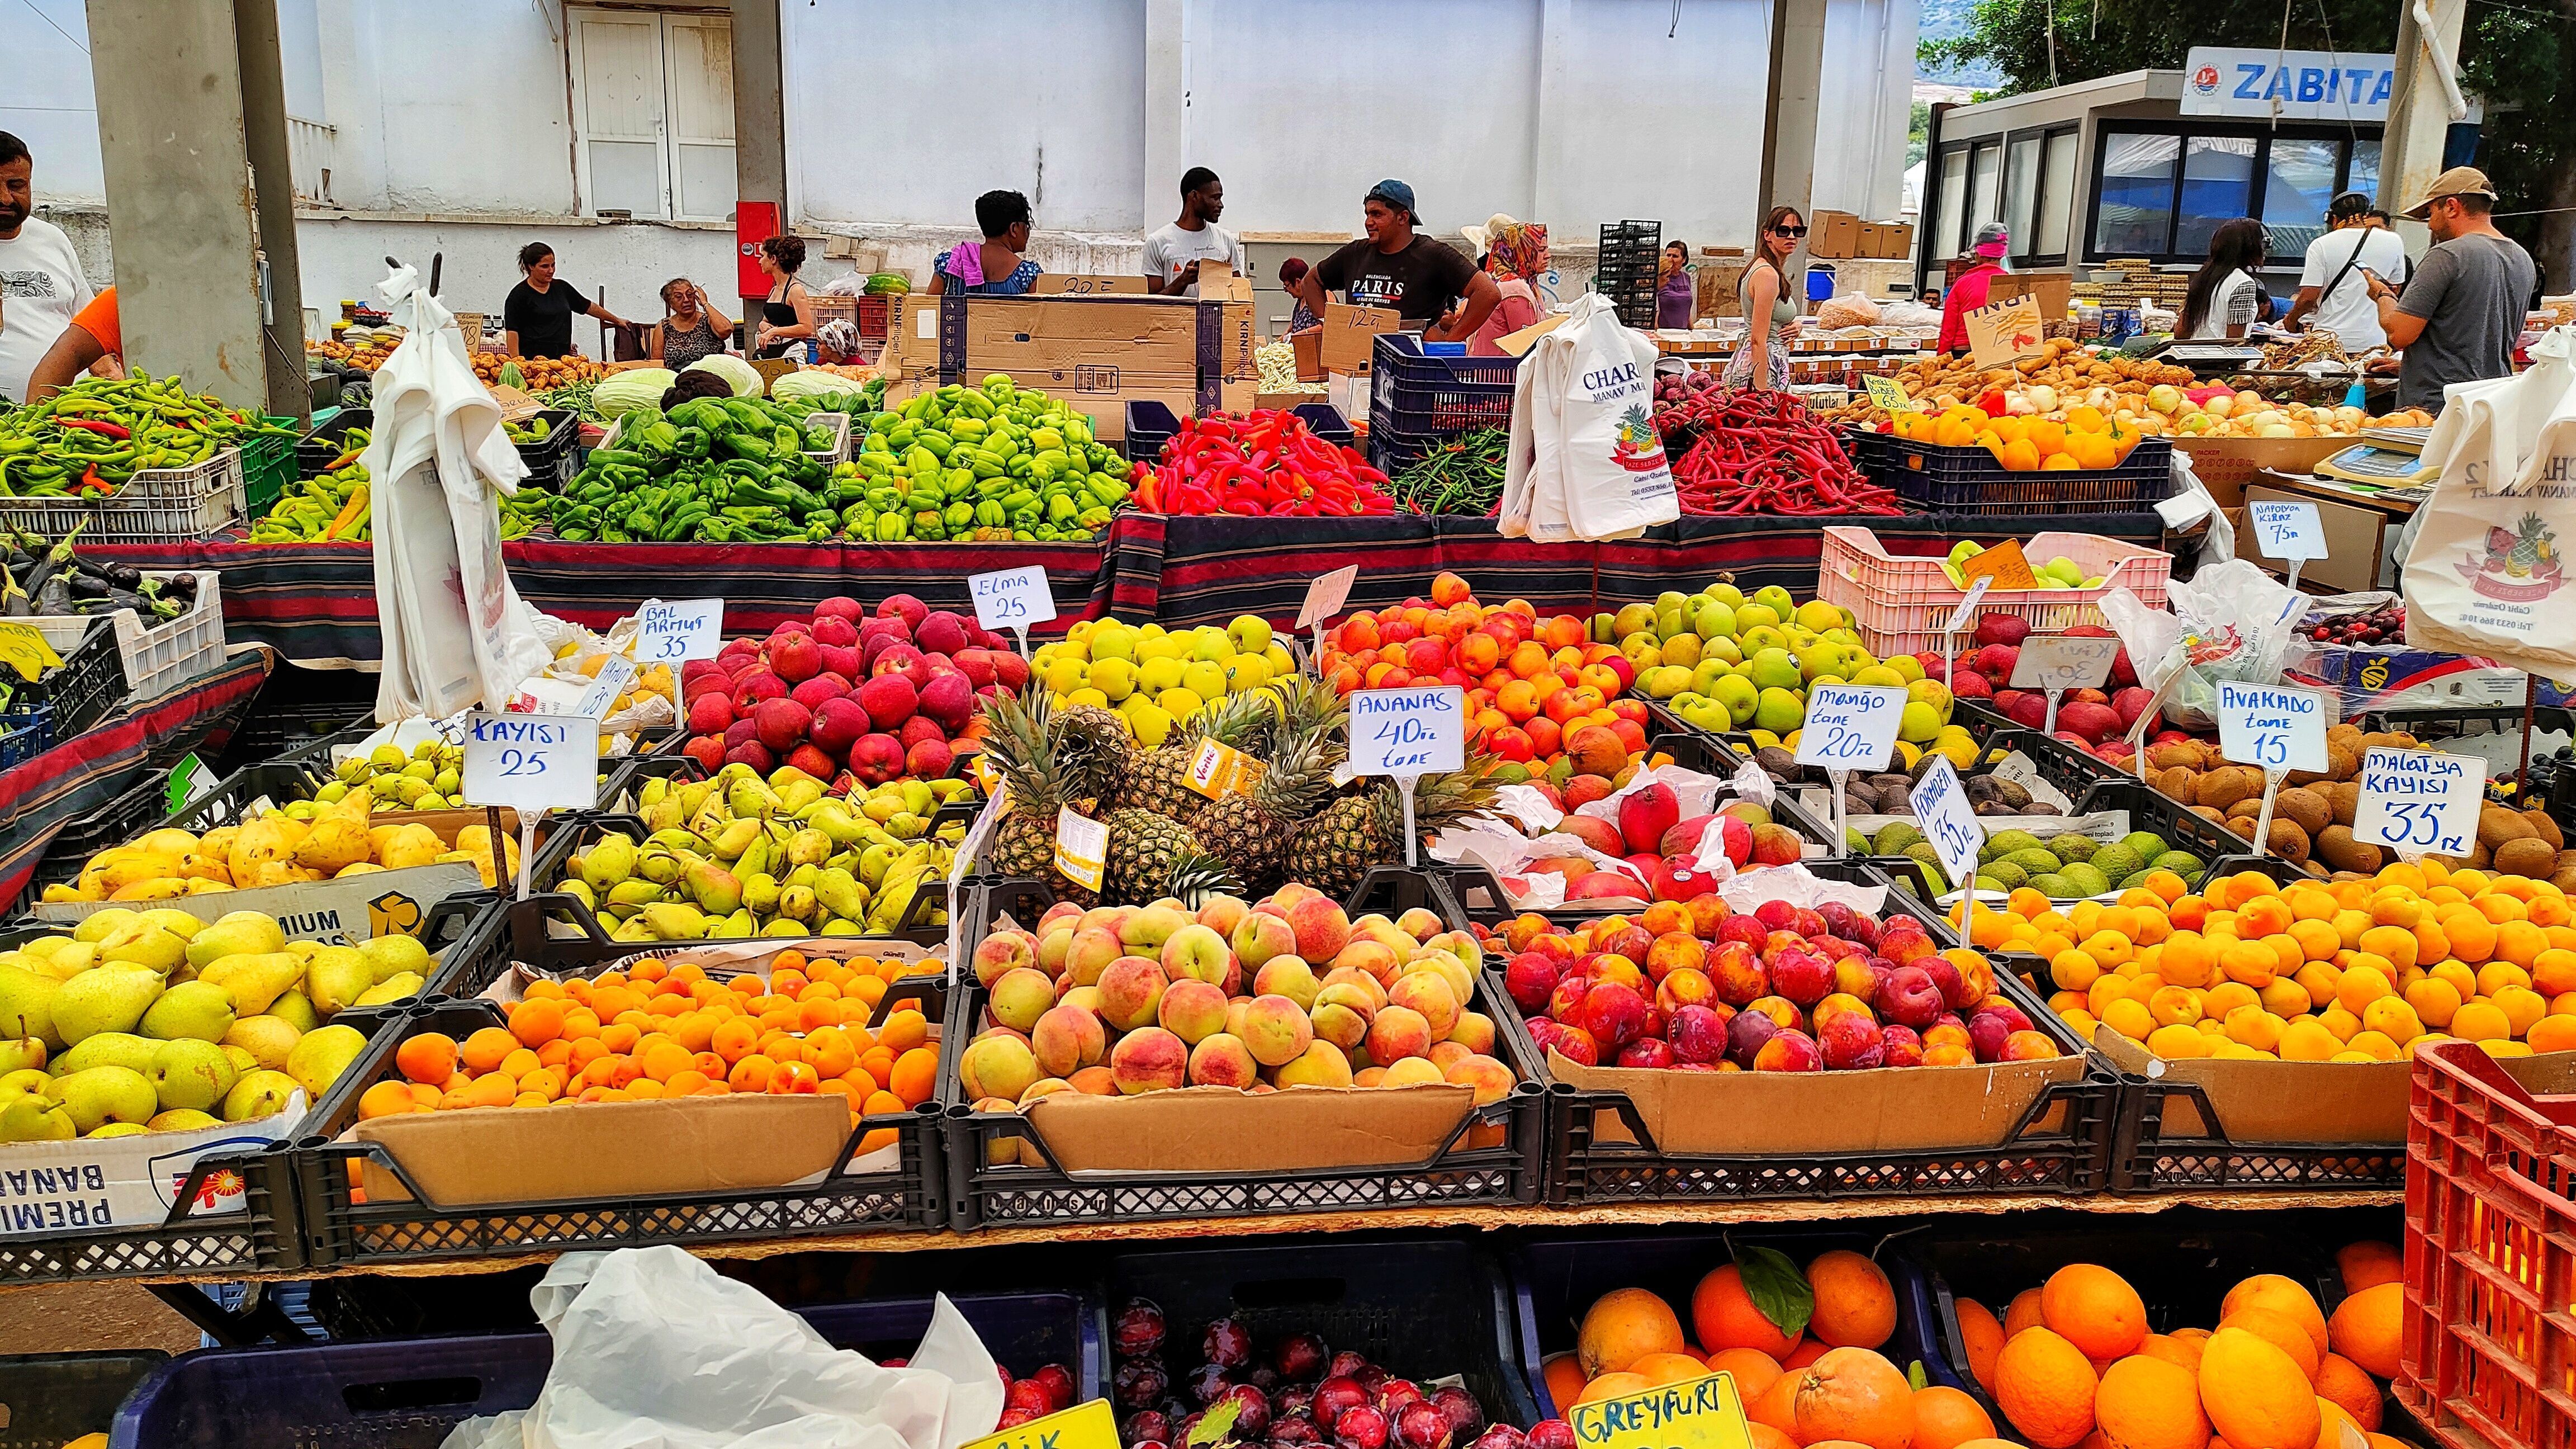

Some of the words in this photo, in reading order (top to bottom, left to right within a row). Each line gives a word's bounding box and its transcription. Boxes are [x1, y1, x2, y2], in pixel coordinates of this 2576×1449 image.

[1352, 280, 1404, 295] PARIS
[461, 325, 477, 345] 18
[1583, 362, 1642, 390] CHAR
[1592, 386, 1626, 402] MANAV
[1810, 394, 1839, 409] ulutlar
[646, 606, 677, 622] BAL
[996, 596, 1026, 618] 25
[645, 615, 707, 635] ARMUT
[656, 636, 690, 659] 35
[599, 660, 630, 685] ARMUT
[583, 686, 608, 715] 35
[1358, 693, 1452, 714] ANANAS
[2223, 687, 2314, 713] AVAKADO
[470, 718, 565, 744] KAYISI
[2253, 733, 2290, 764] 15
[499, 749, 548, 776] 25
[1214, 761, 1227, 783] Ananas
[2366, 774, 2448, 794] KAYISI
[279, 910, 342, 936] MIUM
[0, 1164, 105, 1197] BANA
[0, 1199, 112, 1231] PREMI
[1577, 1378, 1720, 1442] GREYFURT
